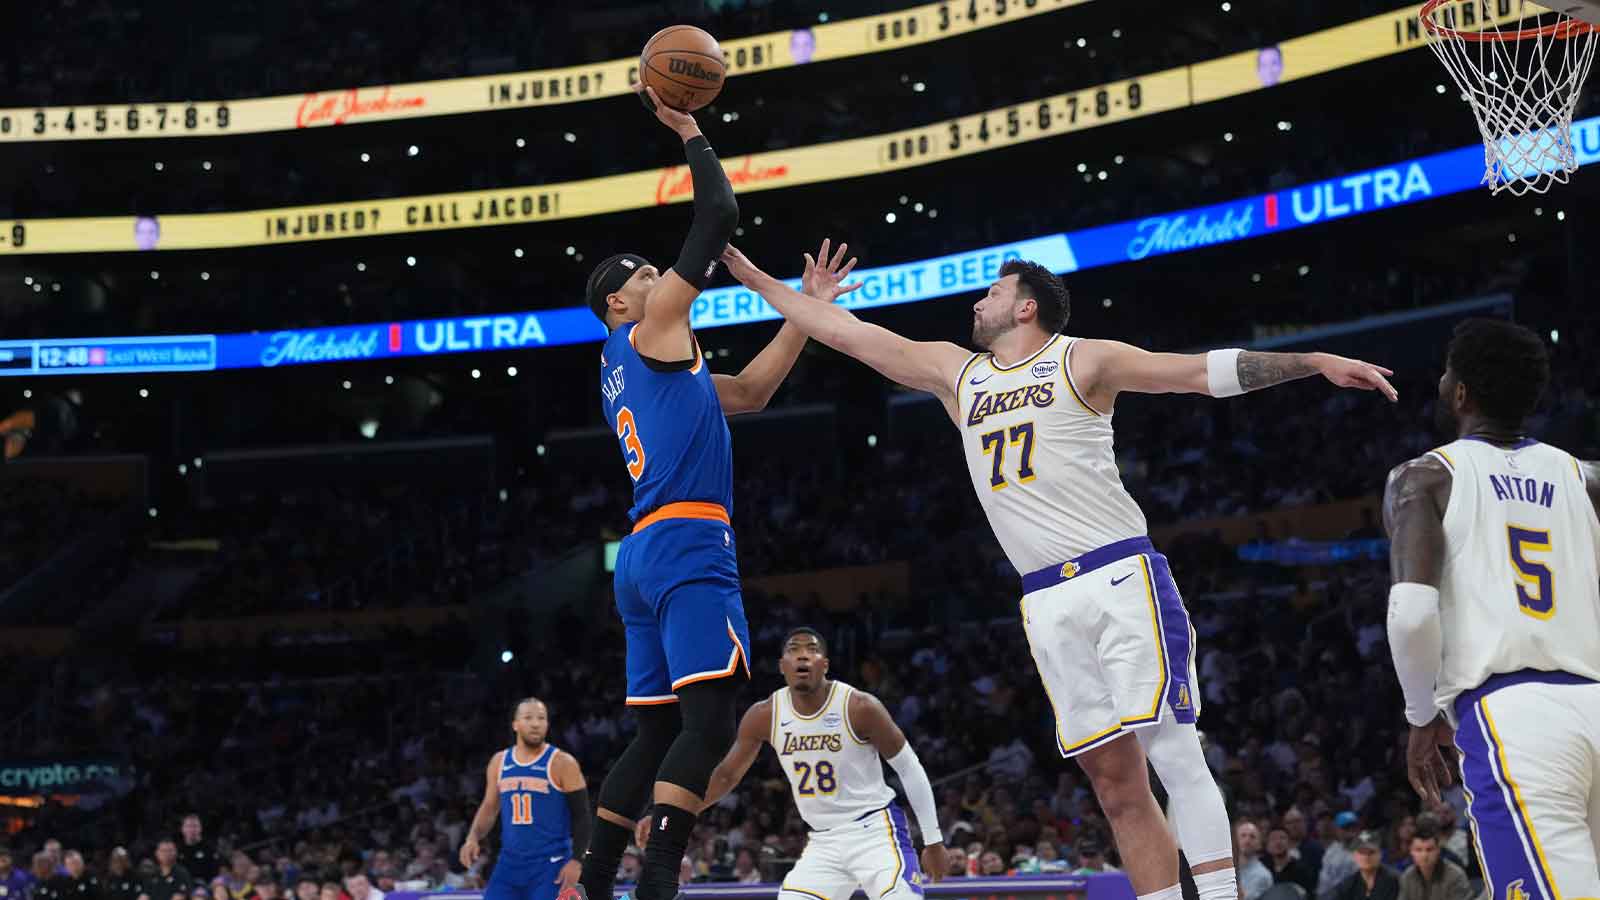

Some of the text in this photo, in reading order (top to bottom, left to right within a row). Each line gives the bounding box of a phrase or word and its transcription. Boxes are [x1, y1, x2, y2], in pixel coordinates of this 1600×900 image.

[489, 73, 603, 105] INJURED?
[669, 57, 720, 80] Wilson
[265, 193, 560, 238] INJURED? CALL JACOB!
[1126, 162, 1432, 260] Michelob ULTRA
[836, 268, 926, 303] IGHT
[261, 316, 546, 367] Michelob ULTRA
[602, 364, 625, 408] HART
[967, 382, 1055, 427] LAKERS
[616, 406, 645, 482] 3
[981, 421, 1037, 492] 77
[1489, 474, 1555, 508] AYTON
[1505, 521, 1557, 622] 5
[780, 732, 843, 755] LAKERS
[793, 759, 837, 798] 28
[511, 792, 532, 824] 11
